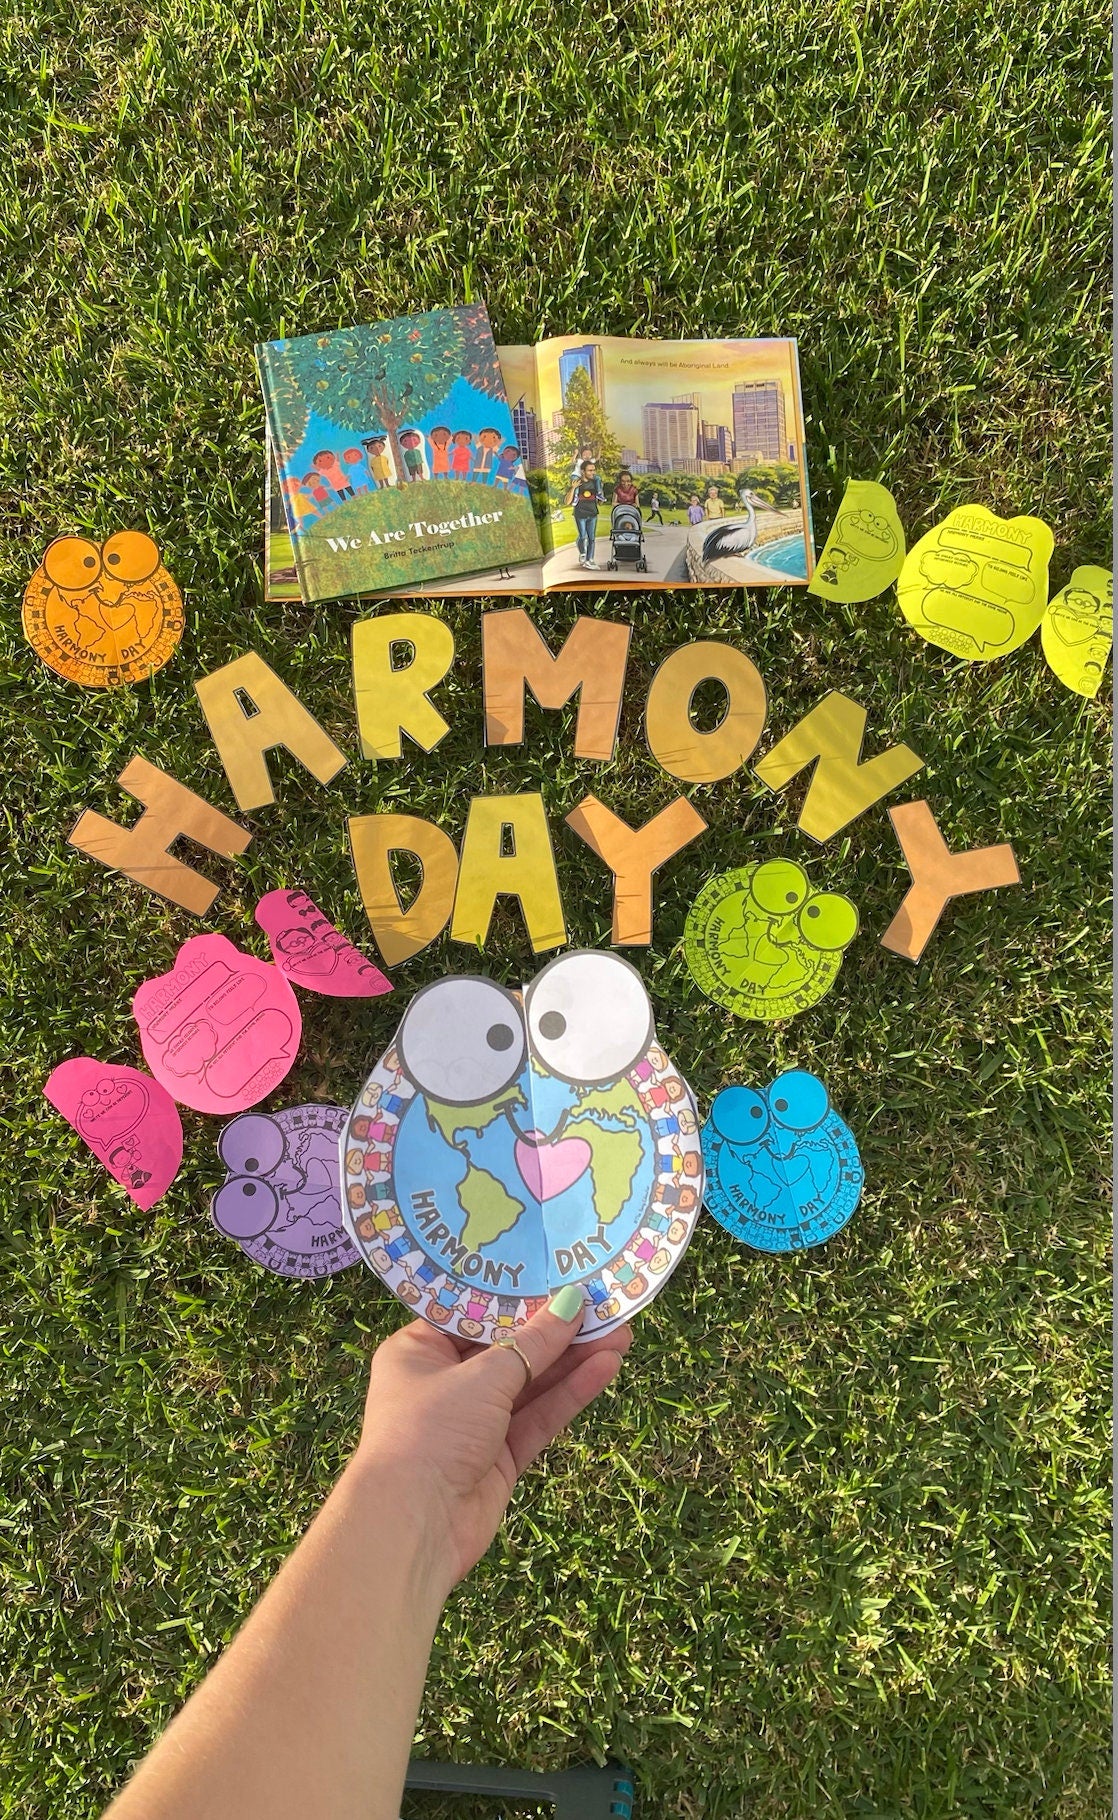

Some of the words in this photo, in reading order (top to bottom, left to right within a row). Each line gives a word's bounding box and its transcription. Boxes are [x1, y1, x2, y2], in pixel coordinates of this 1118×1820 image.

[325, 535, 363, 553] We
[368, 529, 406, 547] Are
[409, 510, 503, 538] Together
[383, 550, 406, 560] Britta
[409, 541, 455, 556] Teckentrup
[953, 514, 1032, 544] HARMONY
[54, 624, 107, 662] HARMONY
[121, 638, 146, 660] DAY
[69, 608, 1020, 964] HARMONY
[348, 793, 707, 967] DAY
[707, 915, 732, 978] HARMONY
[740, 979, 766, 995] DAY
[140, 952, 209, 1020] HARMONY
[728, 1183, 786, 1226] HARMONY
[799, 1191, 826, 1216] DAY
[311, 1225, 348, 1247] HARM
[411, 1188, 525, 1289] HARMONY
[554, 1225, 614, 1276] DAY
